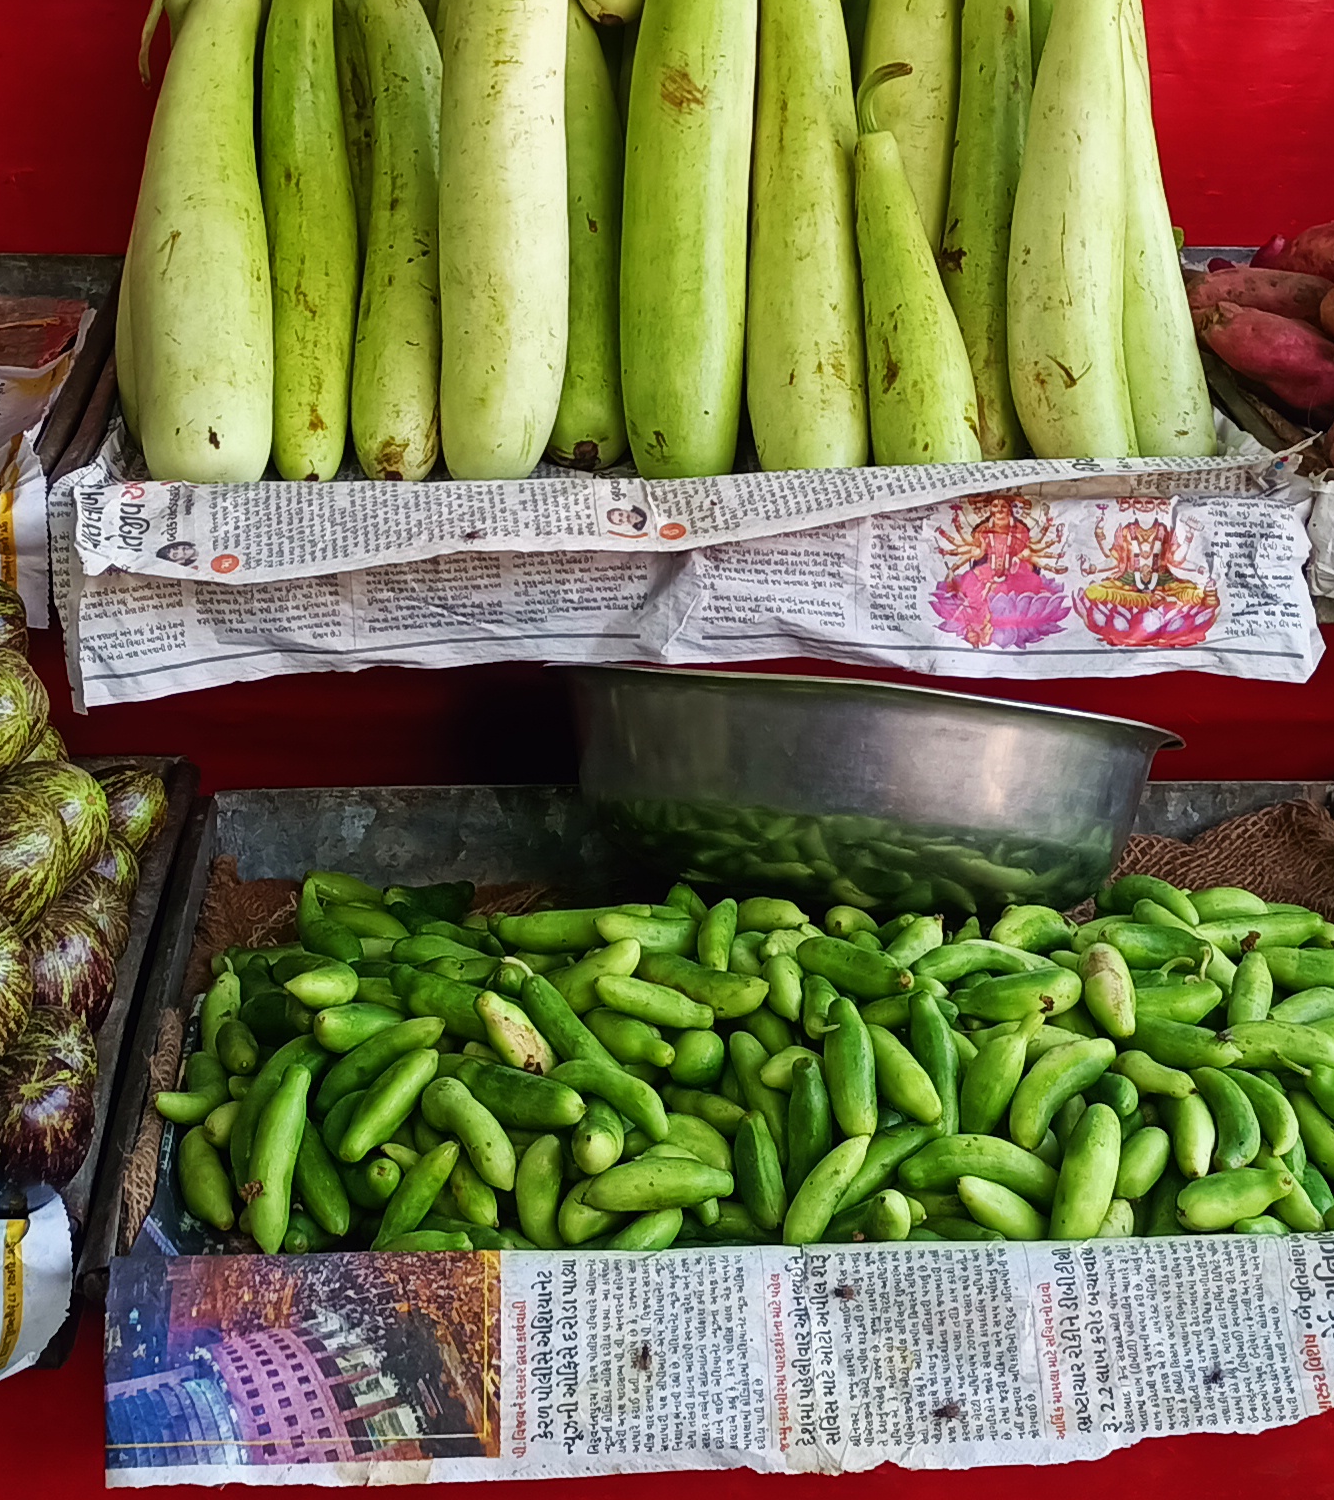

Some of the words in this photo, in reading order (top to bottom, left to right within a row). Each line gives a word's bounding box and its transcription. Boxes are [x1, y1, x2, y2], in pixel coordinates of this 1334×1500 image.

[561, 1259, 578, 1296] પાડ્યા
[811, 1254, 831, 1278] શરૂ
[1051, 1247, 1078, 1311] ડીબીટીથી
[767, 1273, 780, 1298] પહેલ
[809, 1280, 828, 1327] અપીલ
[1036, 1282, 1052, 1304] દાવો
[531, 1270, 553, 1347] એશિયાનેટ
[556, 1298, 578, 1342] દરોડા
[767, 1300, 781, 1318] માટે
[1039, 1305, 1057, 1347] સચિવનો
[1084, 1309, 1106, 1345] કરોડ
[814, 1329, 833, 1366] ઓટો
[1059, 1314, 1083, 1359] રોકીને
[1299, 1334, 1325, 1372] વિશેષ
[531, 1350, 553, 1401] પોલીસે
[556, 1345, 580, 1398] ઓફિસે
[790, 1332, 813, 1399] પહેલીવાર
[1043, 1350, 1058, 1368] માટે
[1093, 1350, 1110, 1383] લાખ
[516, 1367, 527, 1399] સરકાર
[816, 1369, 837, 1396] માટે
[1048, 1369, 1062, 1404] મામલા
[1070, 1362, 1093, 1433] ભ્રષ્ટાચાર
[531, 1404, 554, 1442] કેરળ
[557, 1401, 584, 1454] ન્યૂઝની
[795, 1402, 816, 1446] દેશમાં
[816, 1400, 841, 1445] સર્વિસ
